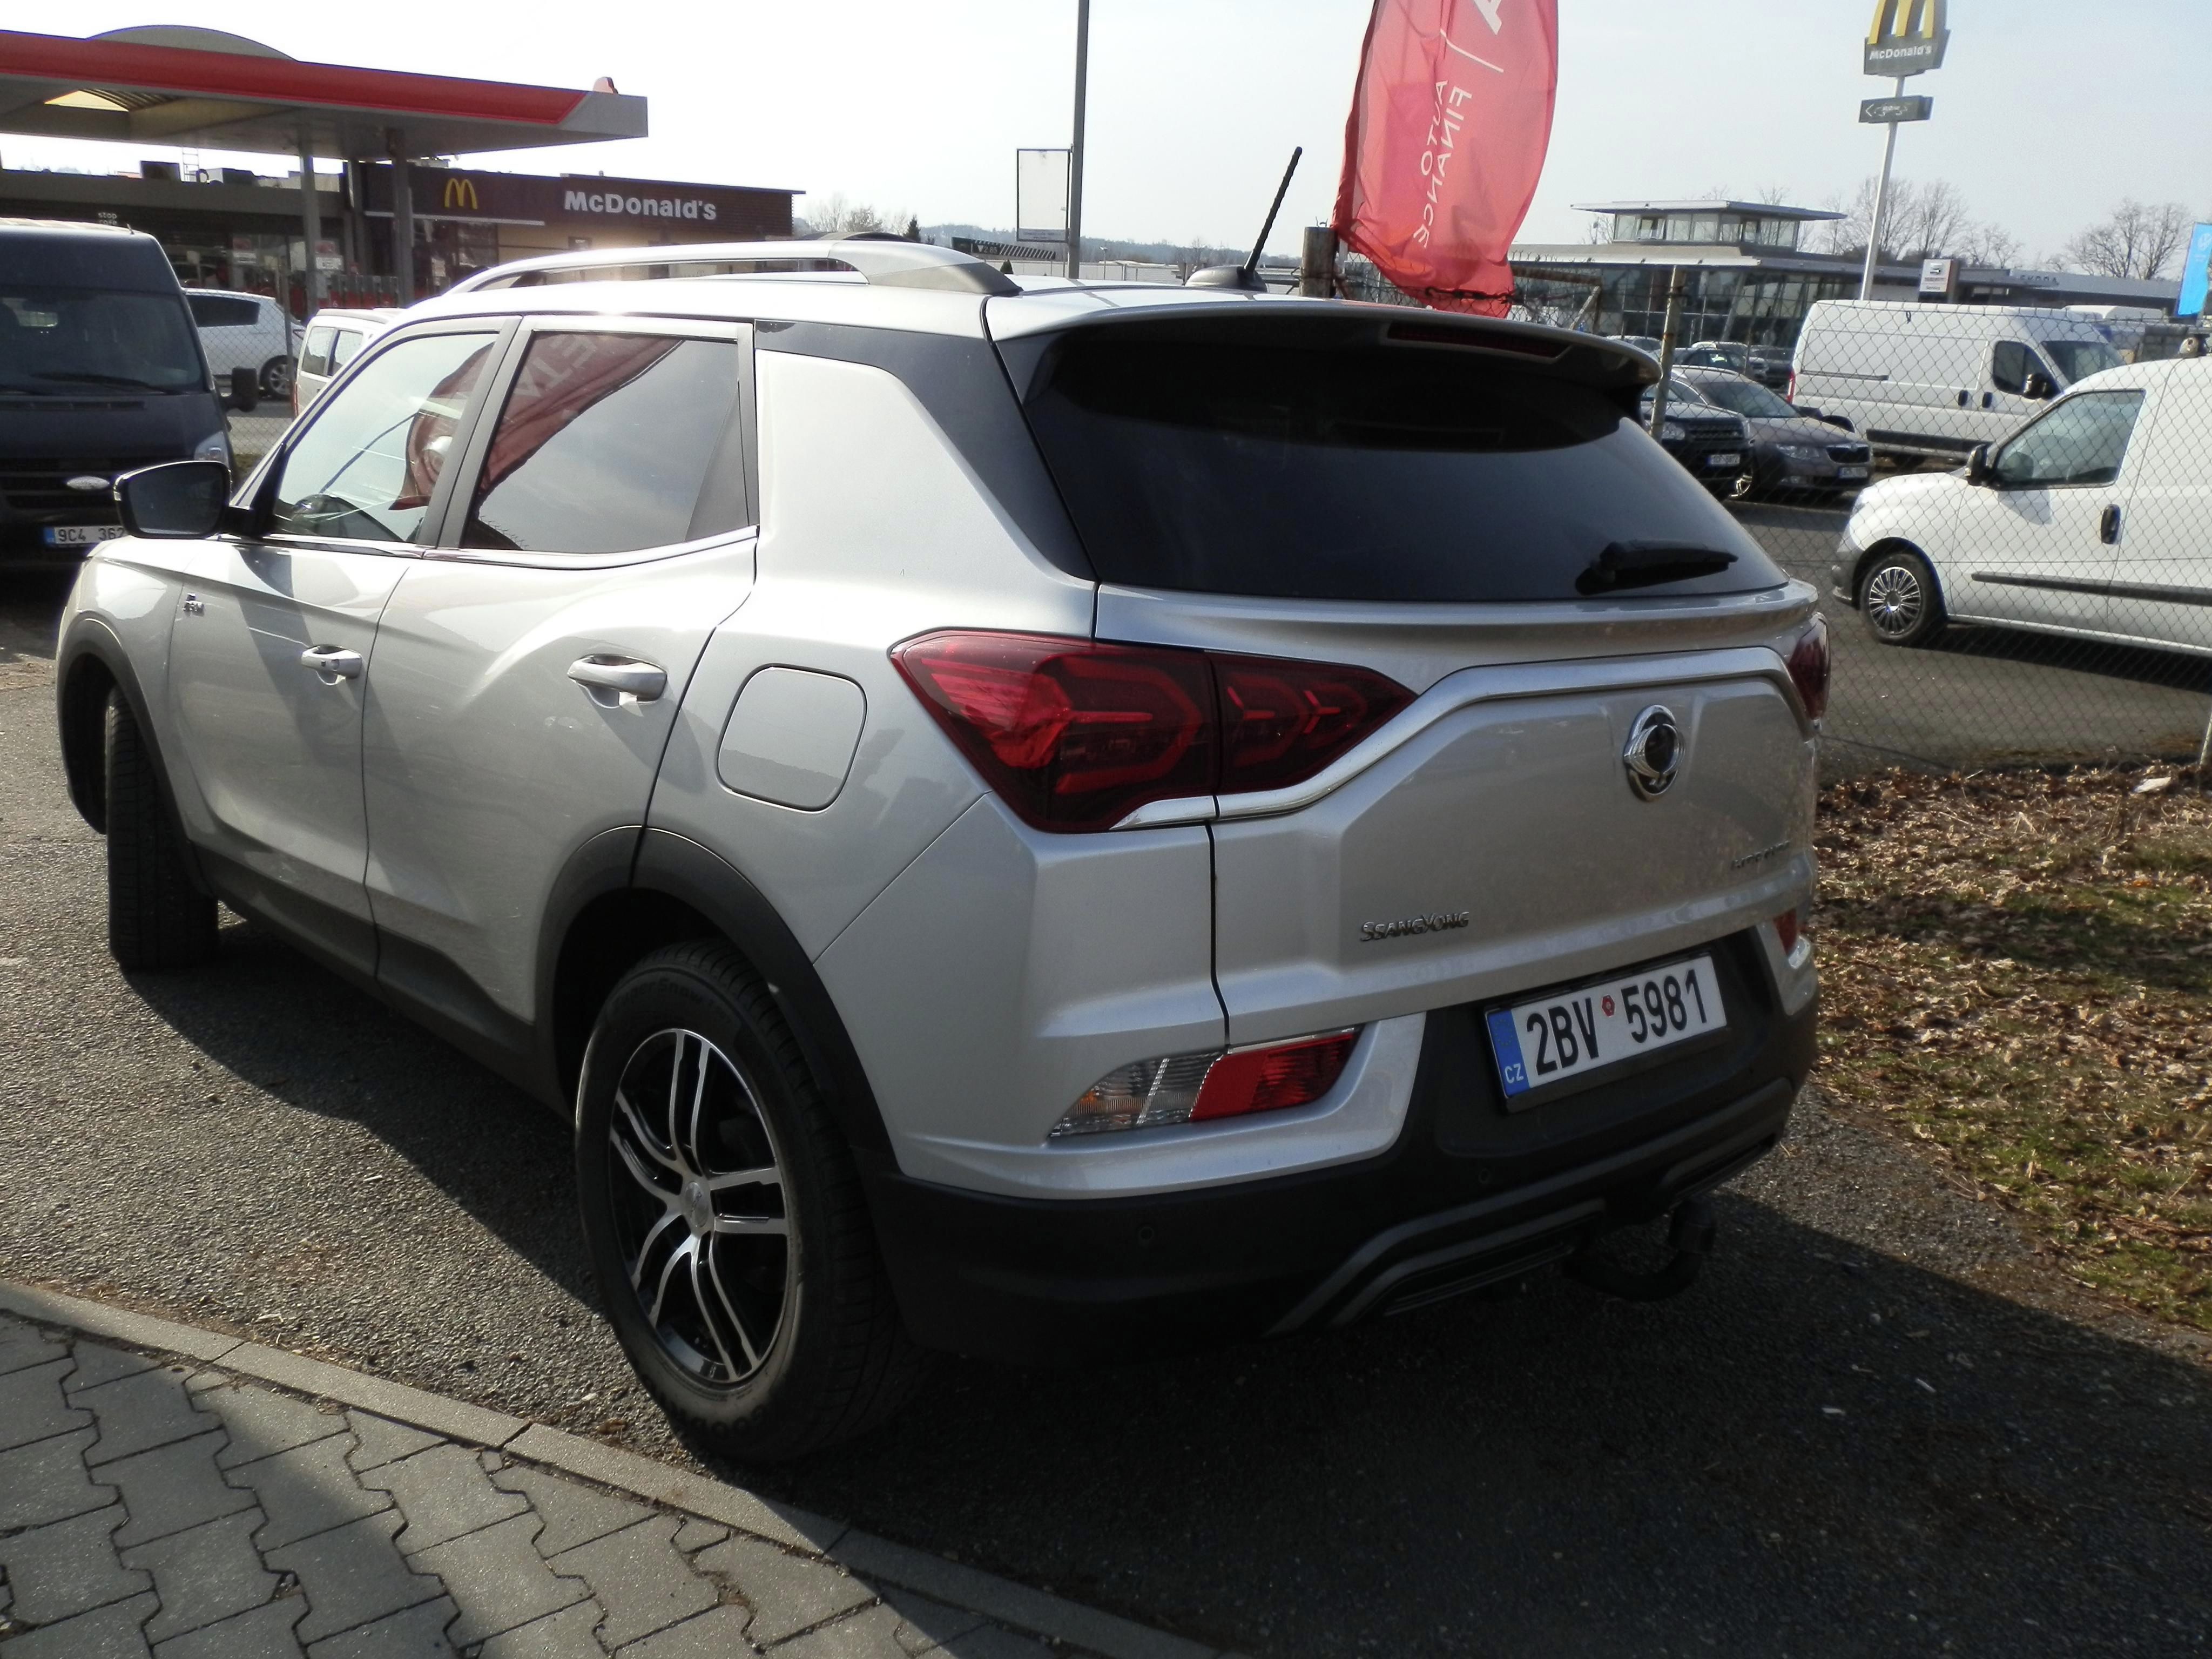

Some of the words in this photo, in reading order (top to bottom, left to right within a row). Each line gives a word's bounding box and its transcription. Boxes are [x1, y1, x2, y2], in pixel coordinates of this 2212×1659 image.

[1870, 45, 1932, 60] McDonald's
[564, 191, 717, 220] McDonald's
[58, 528, 86, 542] 9C4
[98, 527, 125, 541] 362
[1504, 1063, 1525, 1084] CZ
[1526, 996, 1600, 1076] 2BV
[1620, 969, 1707, 1044] 5981
